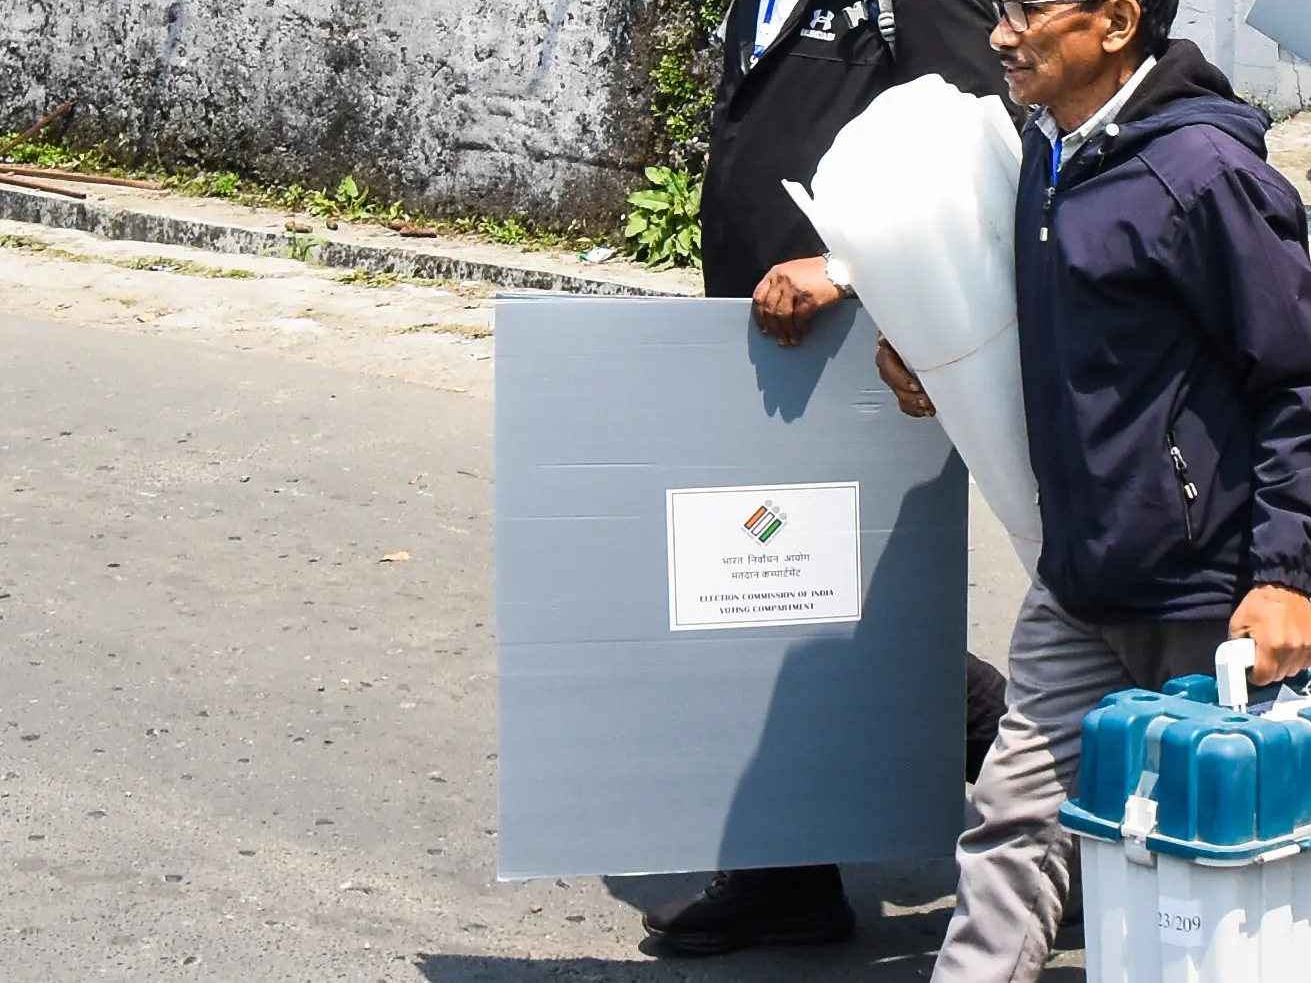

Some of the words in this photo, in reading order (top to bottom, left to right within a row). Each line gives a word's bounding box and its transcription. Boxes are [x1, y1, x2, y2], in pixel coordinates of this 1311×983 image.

[721, 556, 743, 566] भारत
[747, 553, 779, 564] निर्वाचन
[783, 551, 810, 563] आयोग
[731, 570, 759, 580] मतदान
[699, 594, 740, 603] ELECTION
[742, 592, 796, 601] COMMISSION
[797, 590, 809, 599] OF
[811, 589, 834, 597] INDIA
[719, 606, 751, 614] VOTING
[752, 603, 815, 613] COMPARTMENT
[1158, 911, 1202, 933] 23/209
